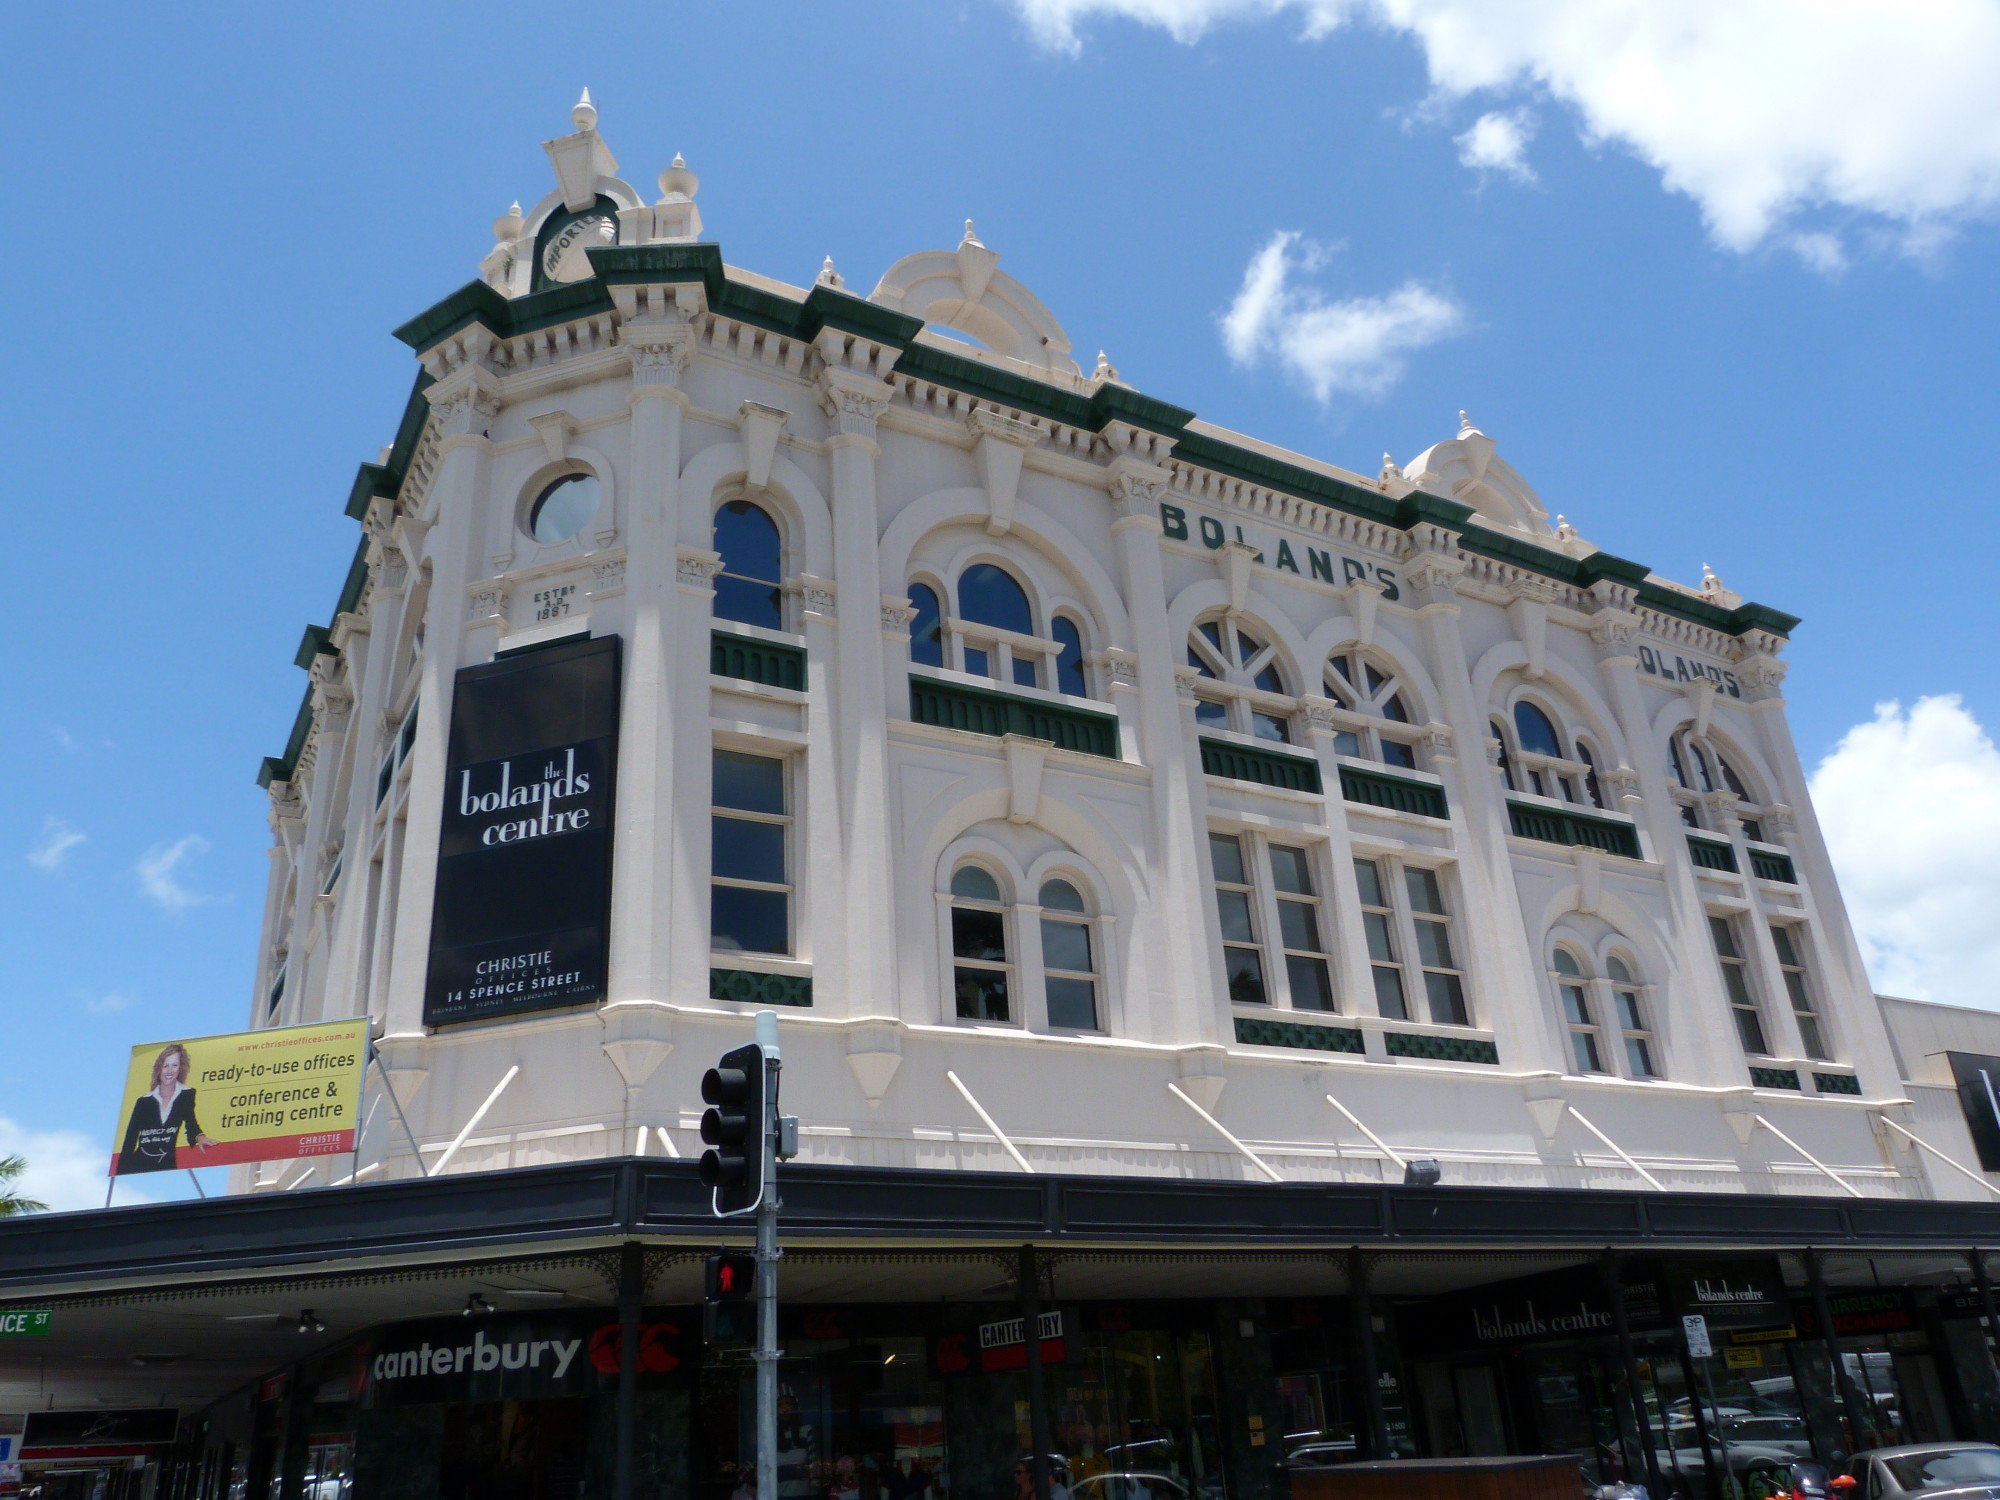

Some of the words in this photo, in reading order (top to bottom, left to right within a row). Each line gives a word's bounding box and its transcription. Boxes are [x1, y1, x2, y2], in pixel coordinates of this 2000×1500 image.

[546, 216, 602, 274] IMPORTE
[537, 603, 570, 621] 1887
[1634, 645, 1741, 699] OLAND'S
[460, 748, 590, 816] bolands
[545, 761, 563, 780] the
[483, 795, 590, 847] centre
[475, 967, 552, 985] OFFICES
[476, 951, 553, 975] CHRISTIE
[447, 990, 462, 1003] 14
[469, 980, 525, 1000] SPENCE
[531, 971, 581, 990] STREET
[237, 1031, 356, 1052] www.christieoffices.com.au
[201, 1060, 299, 1083] ready-to-use
[303, 1053, 355, 1072] offices
[230, 1088, 320, 1108] conference
[326, 1081, 338, 1097] &
[222, 1110, 284, 1128] training
[290, 1102, 343, 1121] centre
[299, 1133, 342, 1146] CHRISTIE
[1694, 1279, 1734, 1301] bolands
[1735, 1284, 1764, 1300] centre
[1828, 1291, 1902, 1316] URRENCY
[35, 1313, 49, 1325] ST
[982, 1314, 1060, 1346] CANTERURY
[1473, 1300, 1546, 1340] bolands
[1551, 1301, 1614, 1332] centre
[1832, 1310, 1911, 1333] XCHANGE
[374, 1331, 582, 1379] canterbury
